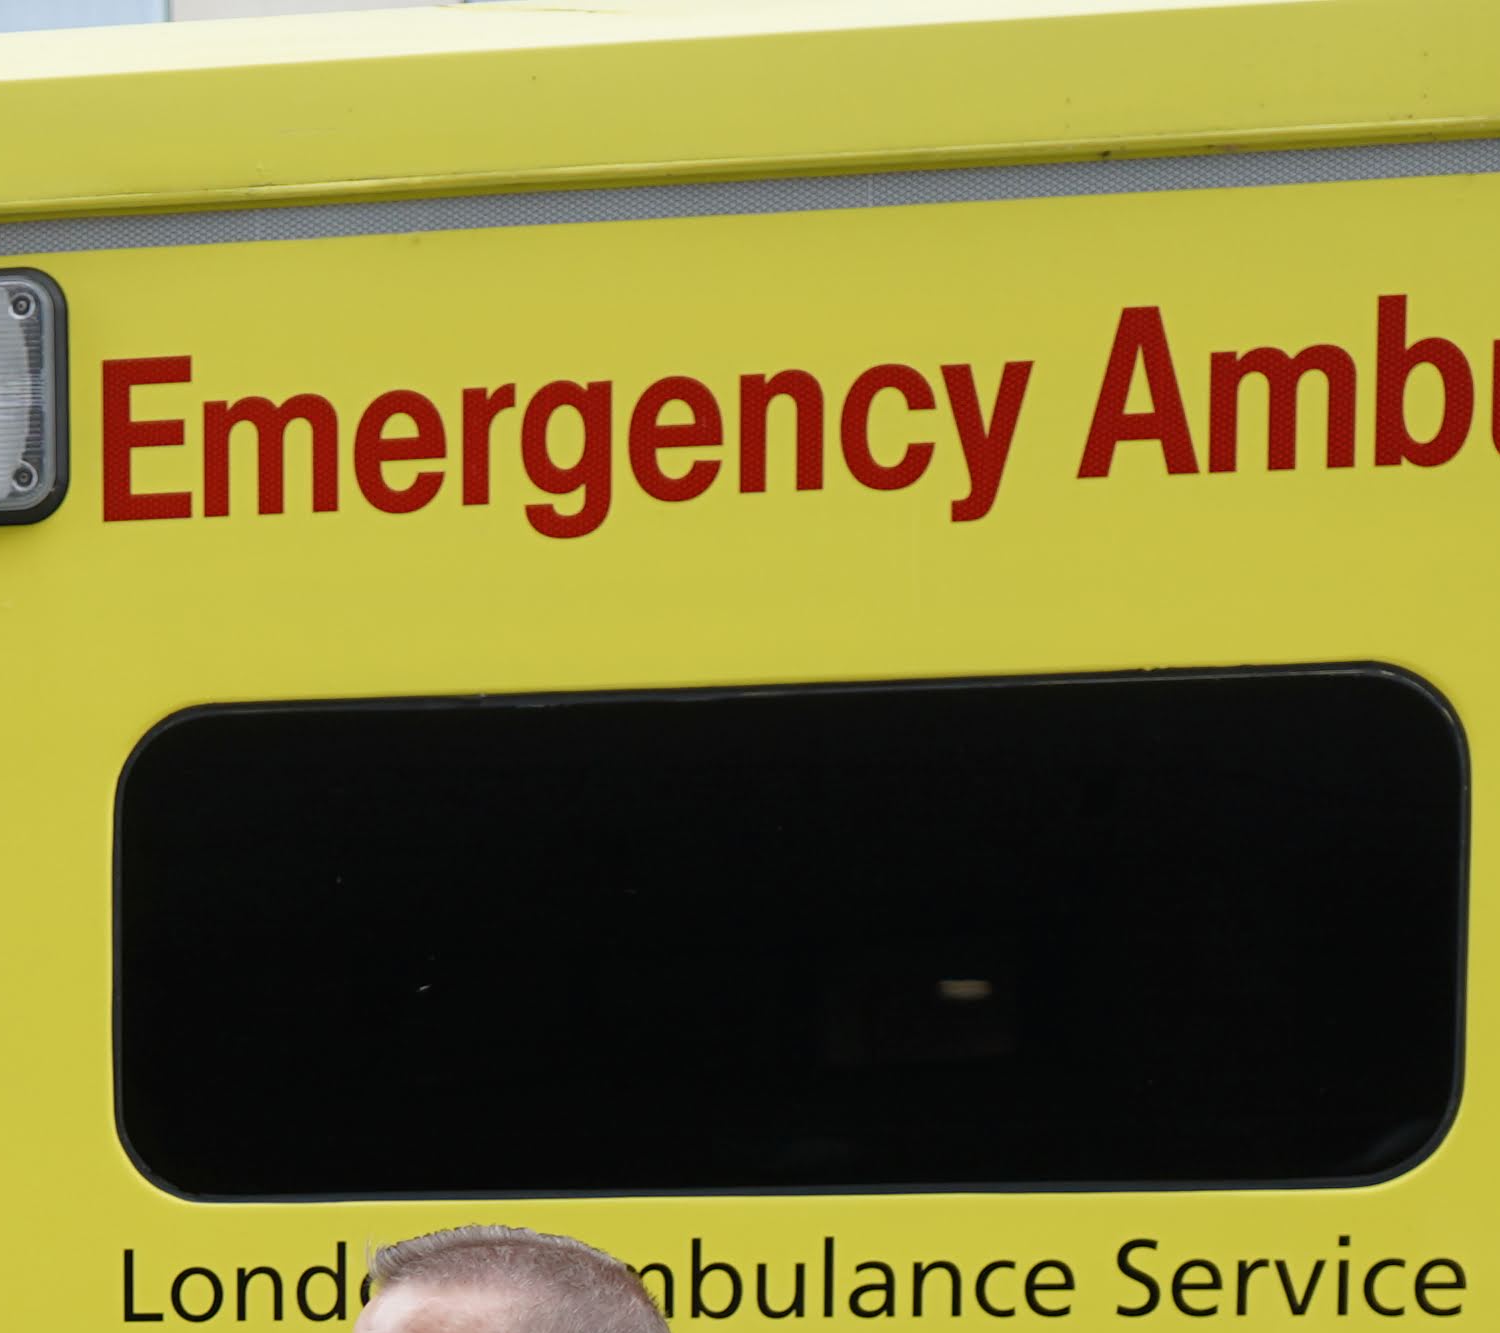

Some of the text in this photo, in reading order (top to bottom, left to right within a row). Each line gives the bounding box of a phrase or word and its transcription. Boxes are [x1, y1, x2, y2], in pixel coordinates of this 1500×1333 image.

[102, 355, 1034, 540] Emergency
[123, 1234, 1468, 1323] Lond bulance Service
